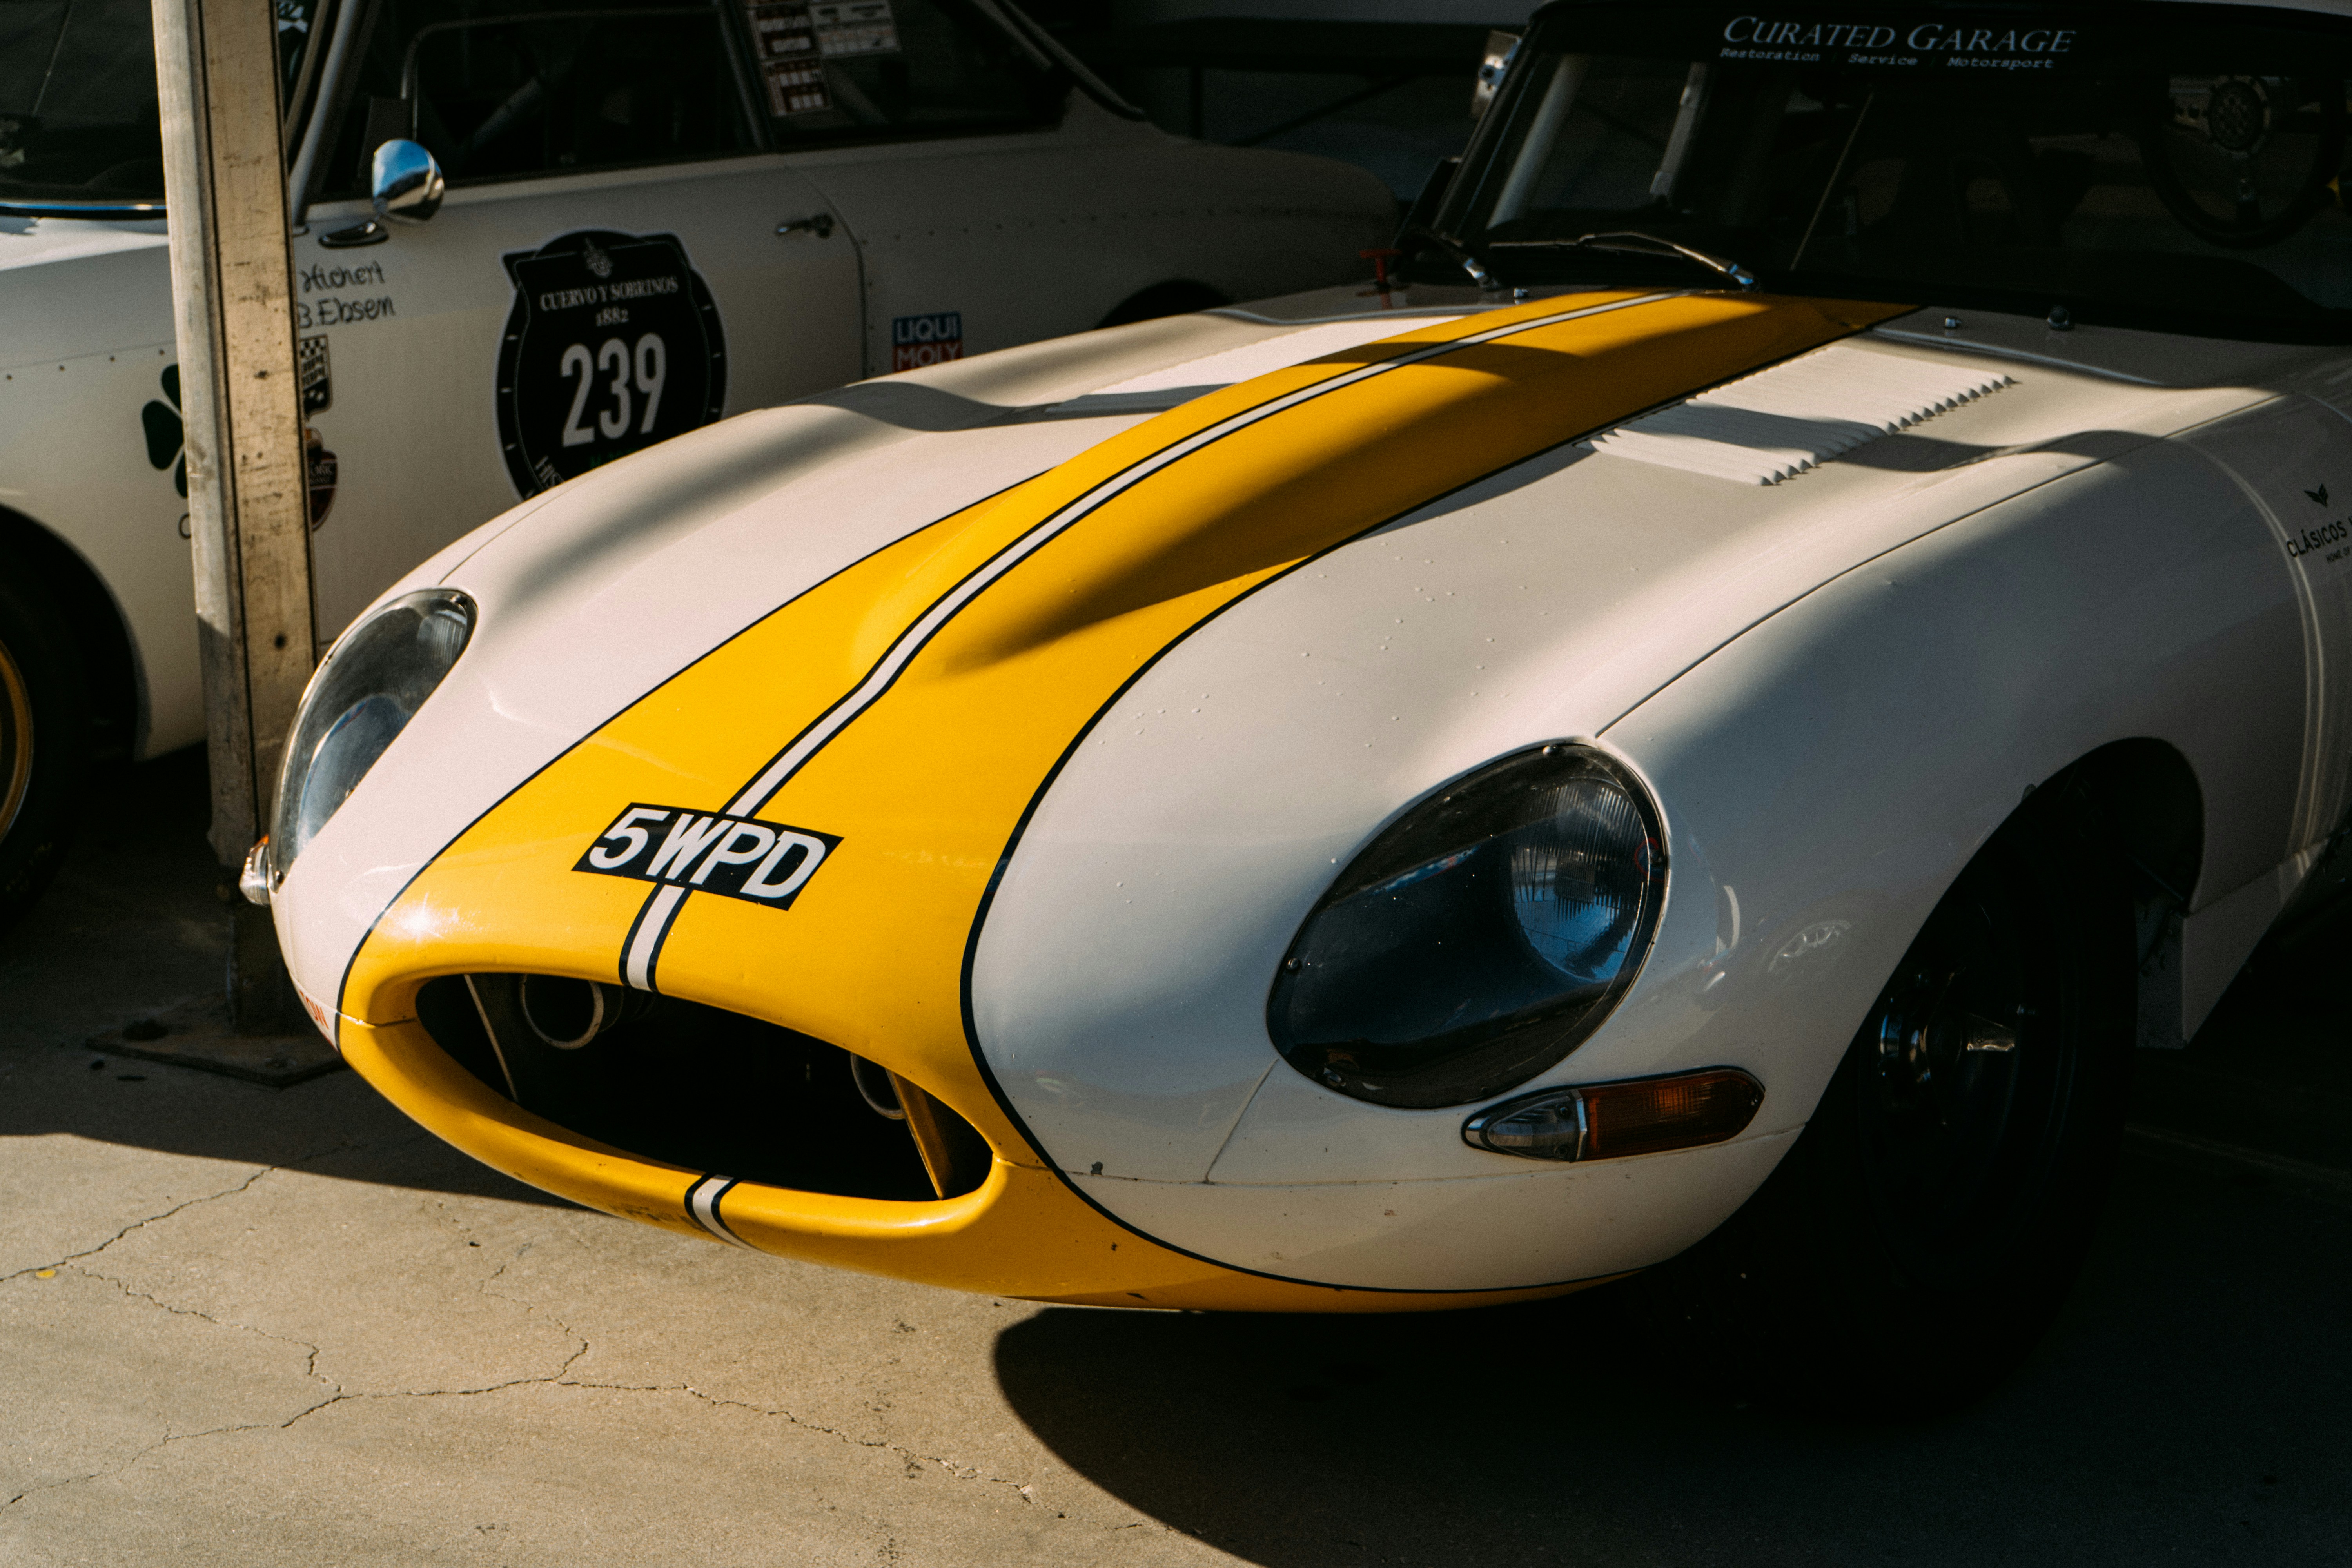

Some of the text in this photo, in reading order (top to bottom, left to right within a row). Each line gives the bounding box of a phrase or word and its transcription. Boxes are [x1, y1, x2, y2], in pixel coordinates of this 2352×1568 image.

[1724, 15, 2077, 53] CURATED GARAGE
[1719, 47, 2055, 71] Restoration Service Motorsport
[539, 275, 679, 312] CUERVO Y SOBRINOS
[595, 305, 629, 327] 1882
[896, 315, 959, 343] LIQUI
[560, 332, 667, 448] 239
[2287, 520, 2347, 557] CLÁSICOS
